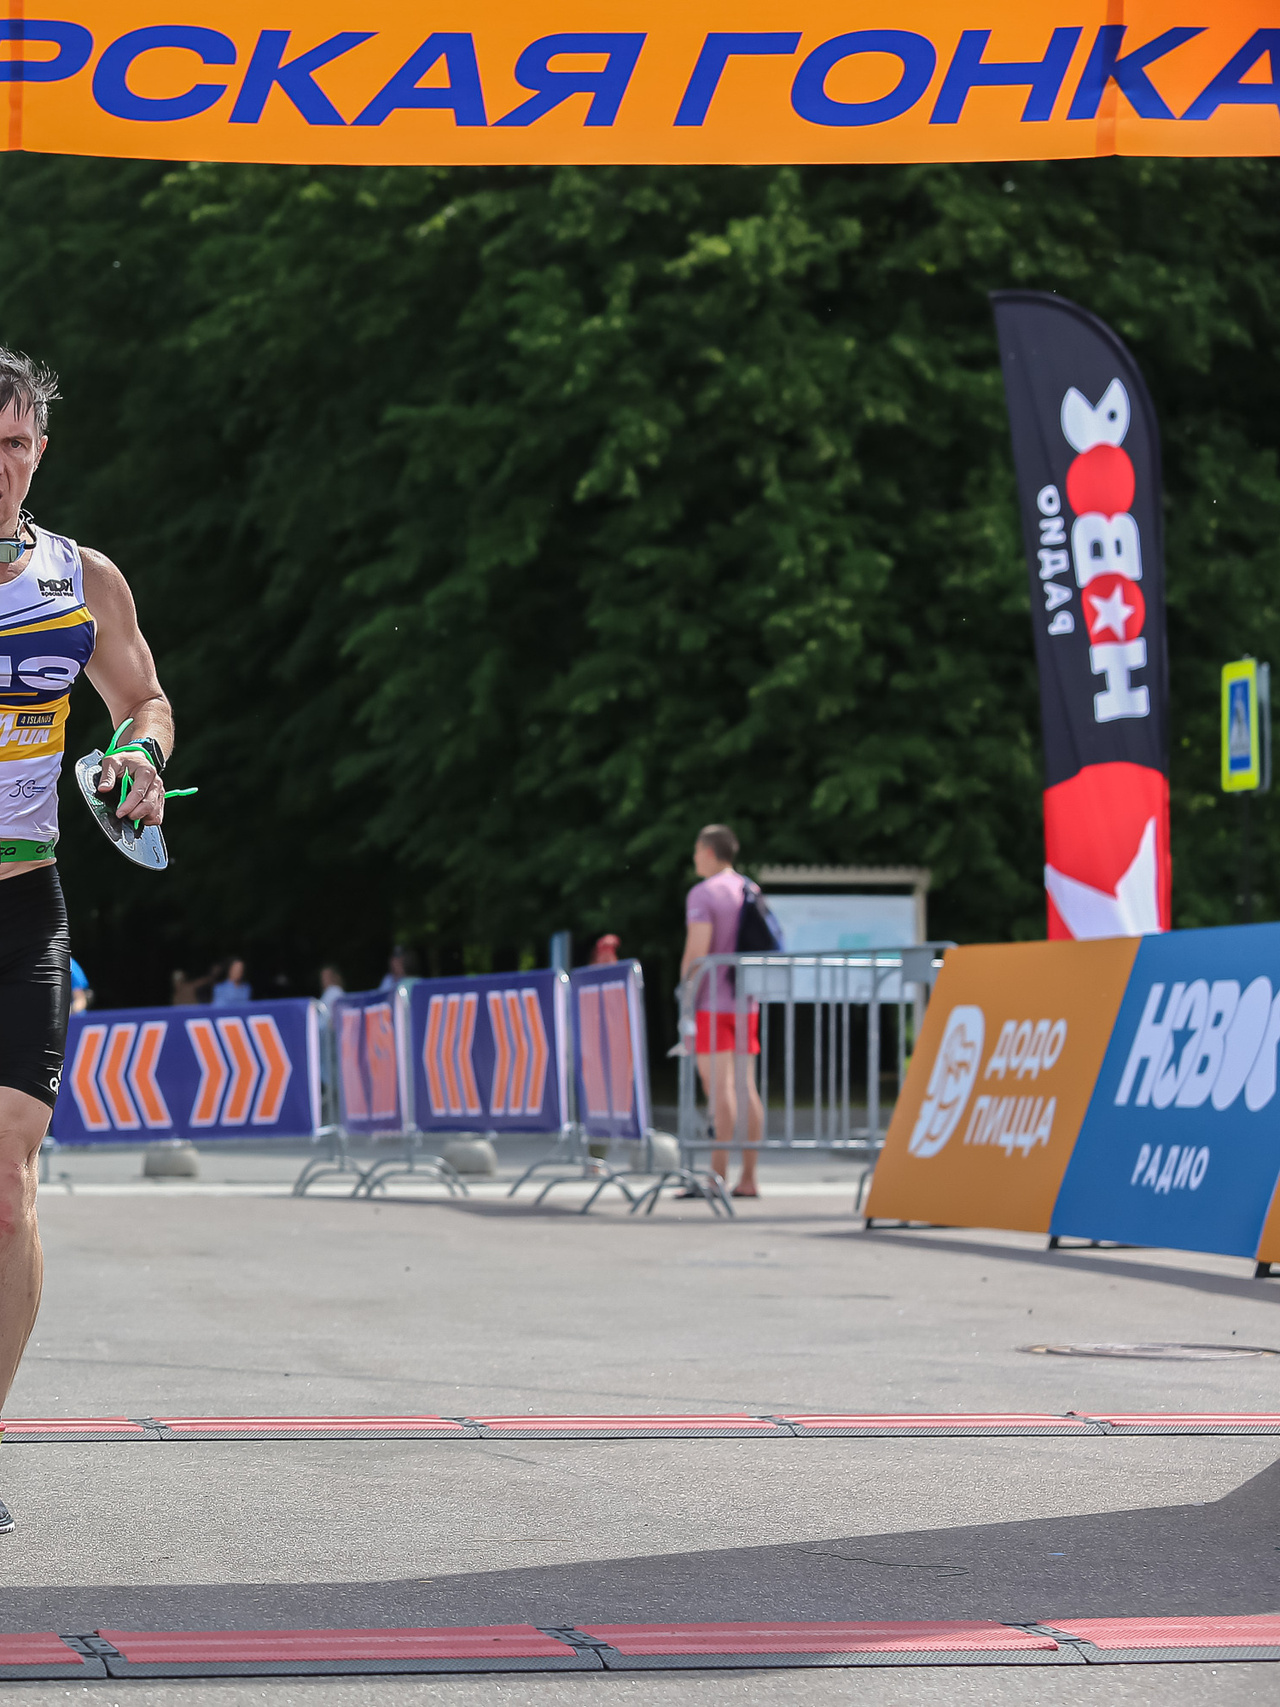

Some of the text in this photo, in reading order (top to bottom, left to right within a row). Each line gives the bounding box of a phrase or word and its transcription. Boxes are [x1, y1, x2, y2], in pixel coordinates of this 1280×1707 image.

[673, 25, 1280, 127] ГОНКА
[983, 1018, 1068, 1081] ДОДО
[963, 1095, 1057, 1158] ПИЦЦА
[1130, 1142, 1210, 1195] РАДИО
